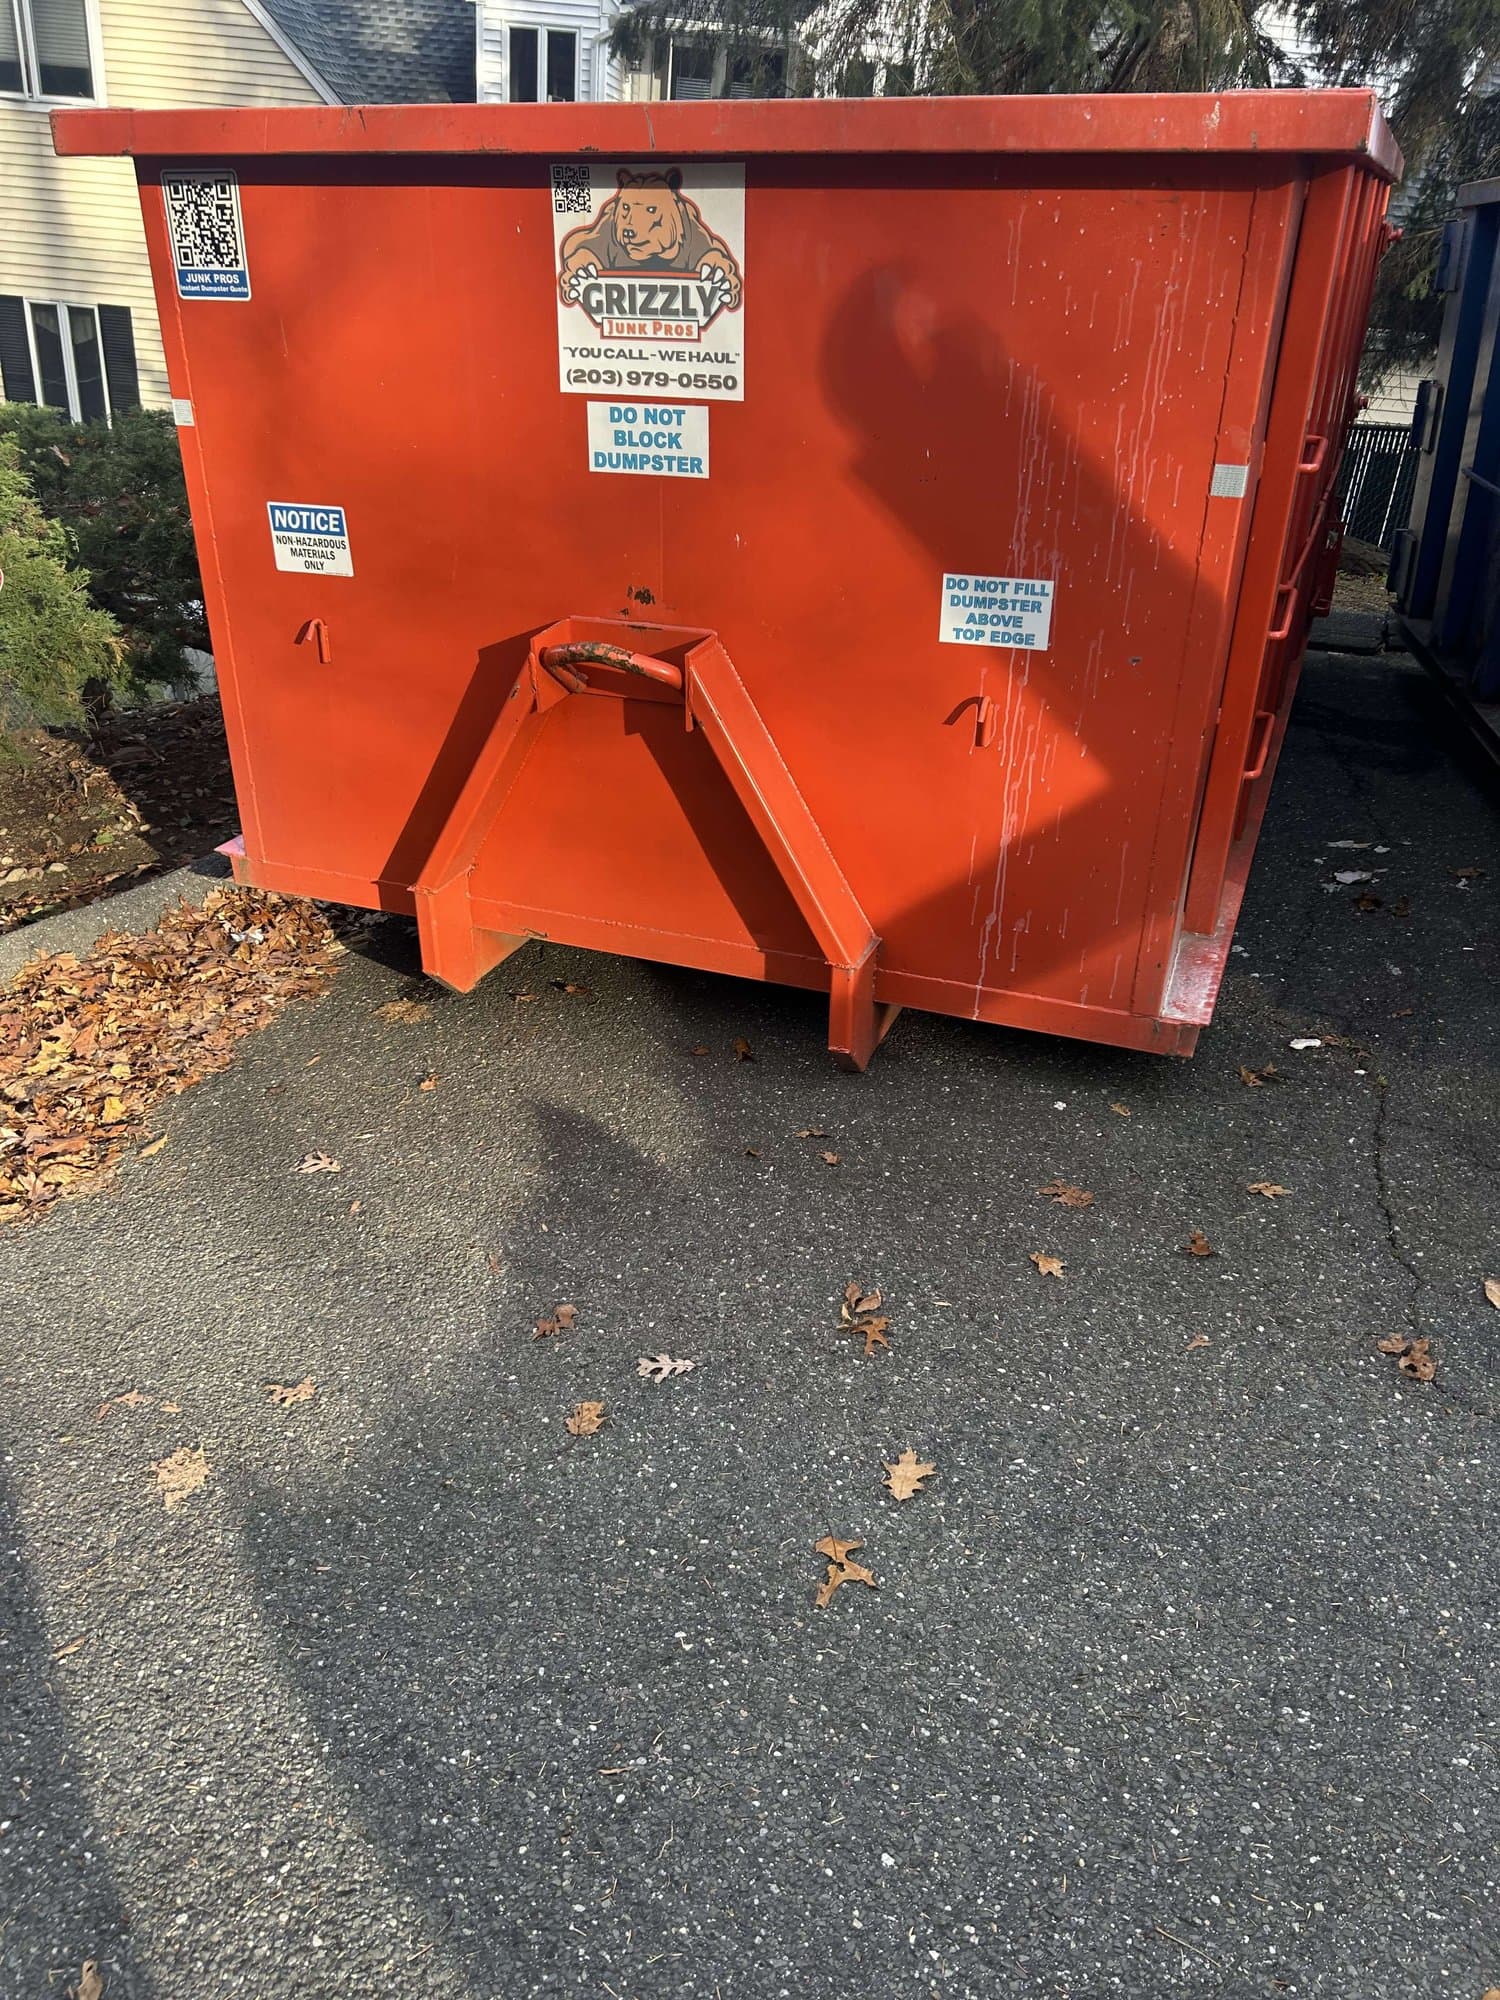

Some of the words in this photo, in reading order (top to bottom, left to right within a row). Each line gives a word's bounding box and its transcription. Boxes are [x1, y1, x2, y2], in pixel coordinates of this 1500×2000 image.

[185, 272, 212, 284] JUNK
[213, 273, 240, 284] PROS
[201, 285, 229, 293] Dumpster
[582, 282, 721, 318] GRIZZLY
[566, 368, 623, 387] (203)
[626, 370, 738, 391] 979-0550
[609, 406, 638, 424] DO
[644, 407, 686, 426] NOT
[613, 429, 683, 450] BLOCK
[594, 451, 704, 474] DUMPSTER
[274, 509, 341, 532] NOTICE
[275, 534, 347, 550] NON-HAZARDOUS
[290, 547, 336, 561] MATERIALS
[304, 560, 325, 571] ONLY
[945, 577, 969, 591] DO
[974, 579, 1009, 593] NOT
[1014, 582, 1050, 597] FILL
[950, 594, 1042, 614] DUMPSTER
[965, 612, 1024, 628] ABOVE
[953, 627, 986, 641] TOP
[990, 630, 1036, 646] EDGE
